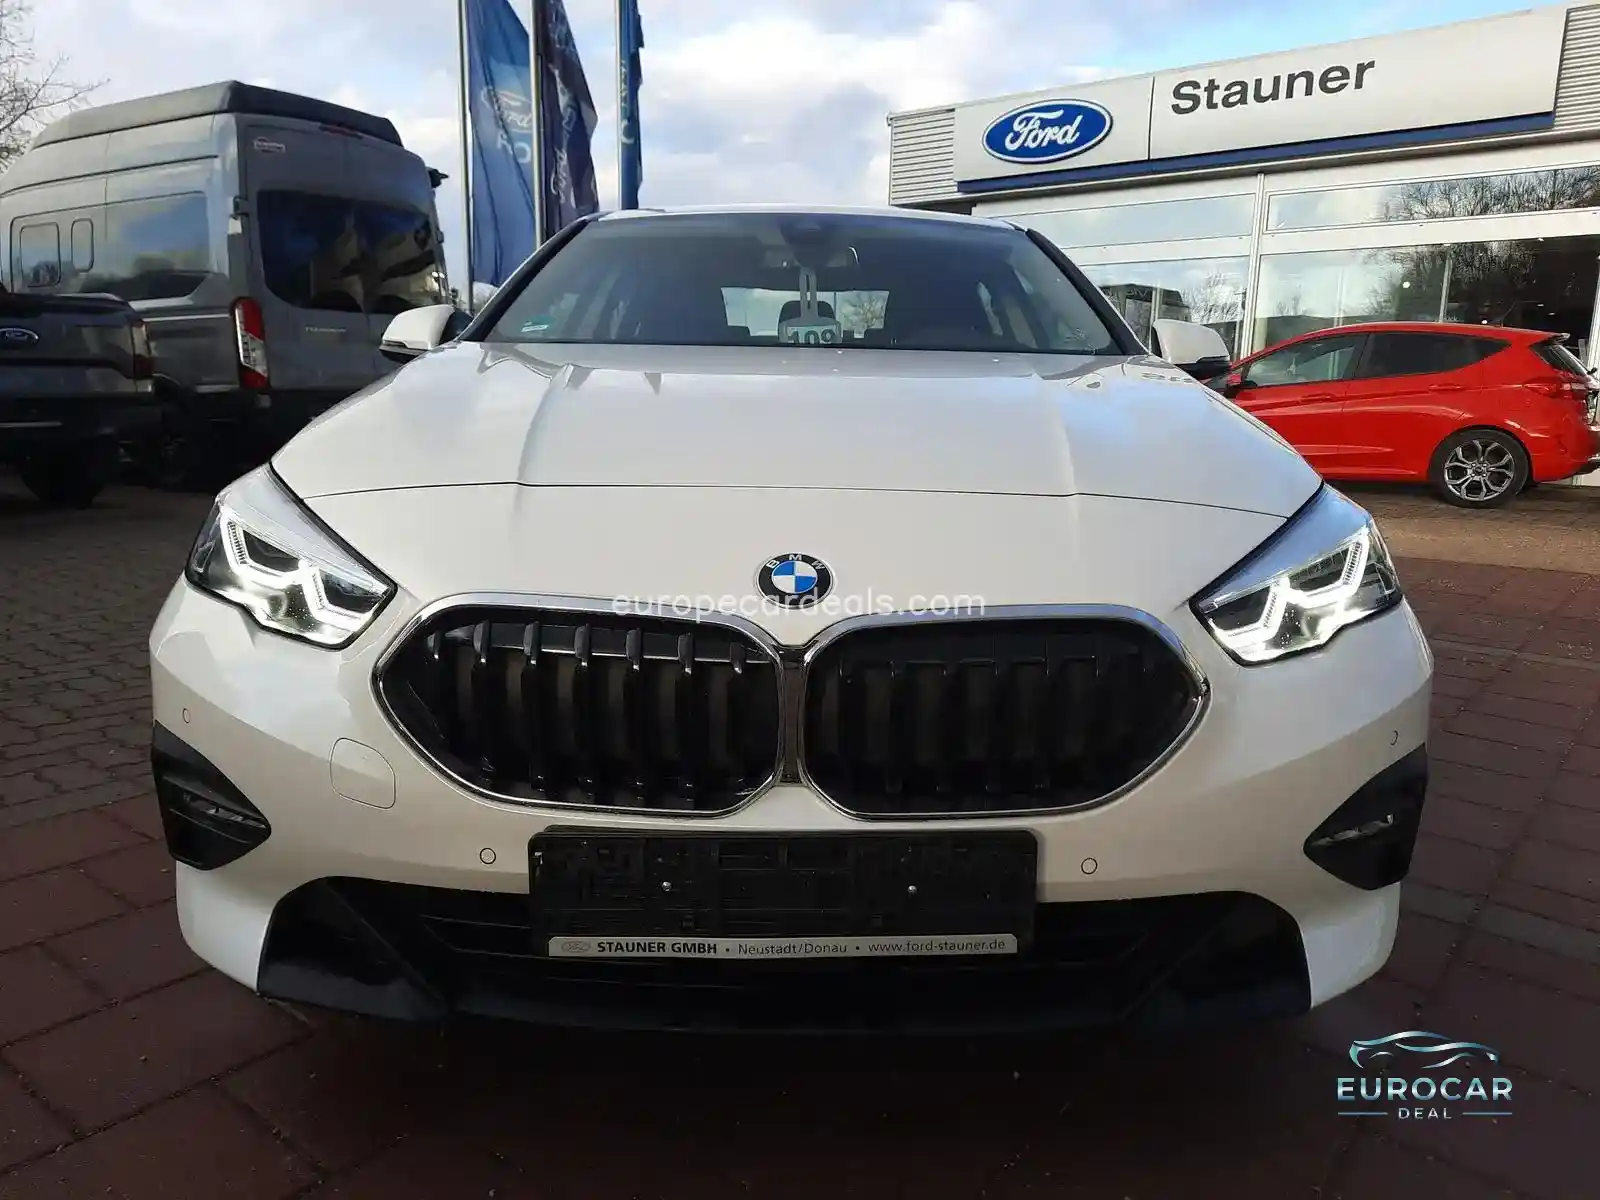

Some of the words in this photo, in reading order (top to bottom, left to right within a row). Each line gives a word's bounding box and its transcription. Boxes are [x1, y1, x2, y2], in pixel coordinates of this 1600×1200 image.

[1171, 60, 1376, 115] Stauner
[1005, 108, 1081, 151] Ford
[765, 554, 826, 570] BMW
[597, 941, 666, 953] STAUNER
[671, 942, 717, 954] GMBH
[738, 942, 848, 955] Neustadt/Donau
[867, 939, 1006, 952] www.ford-stauner.de
